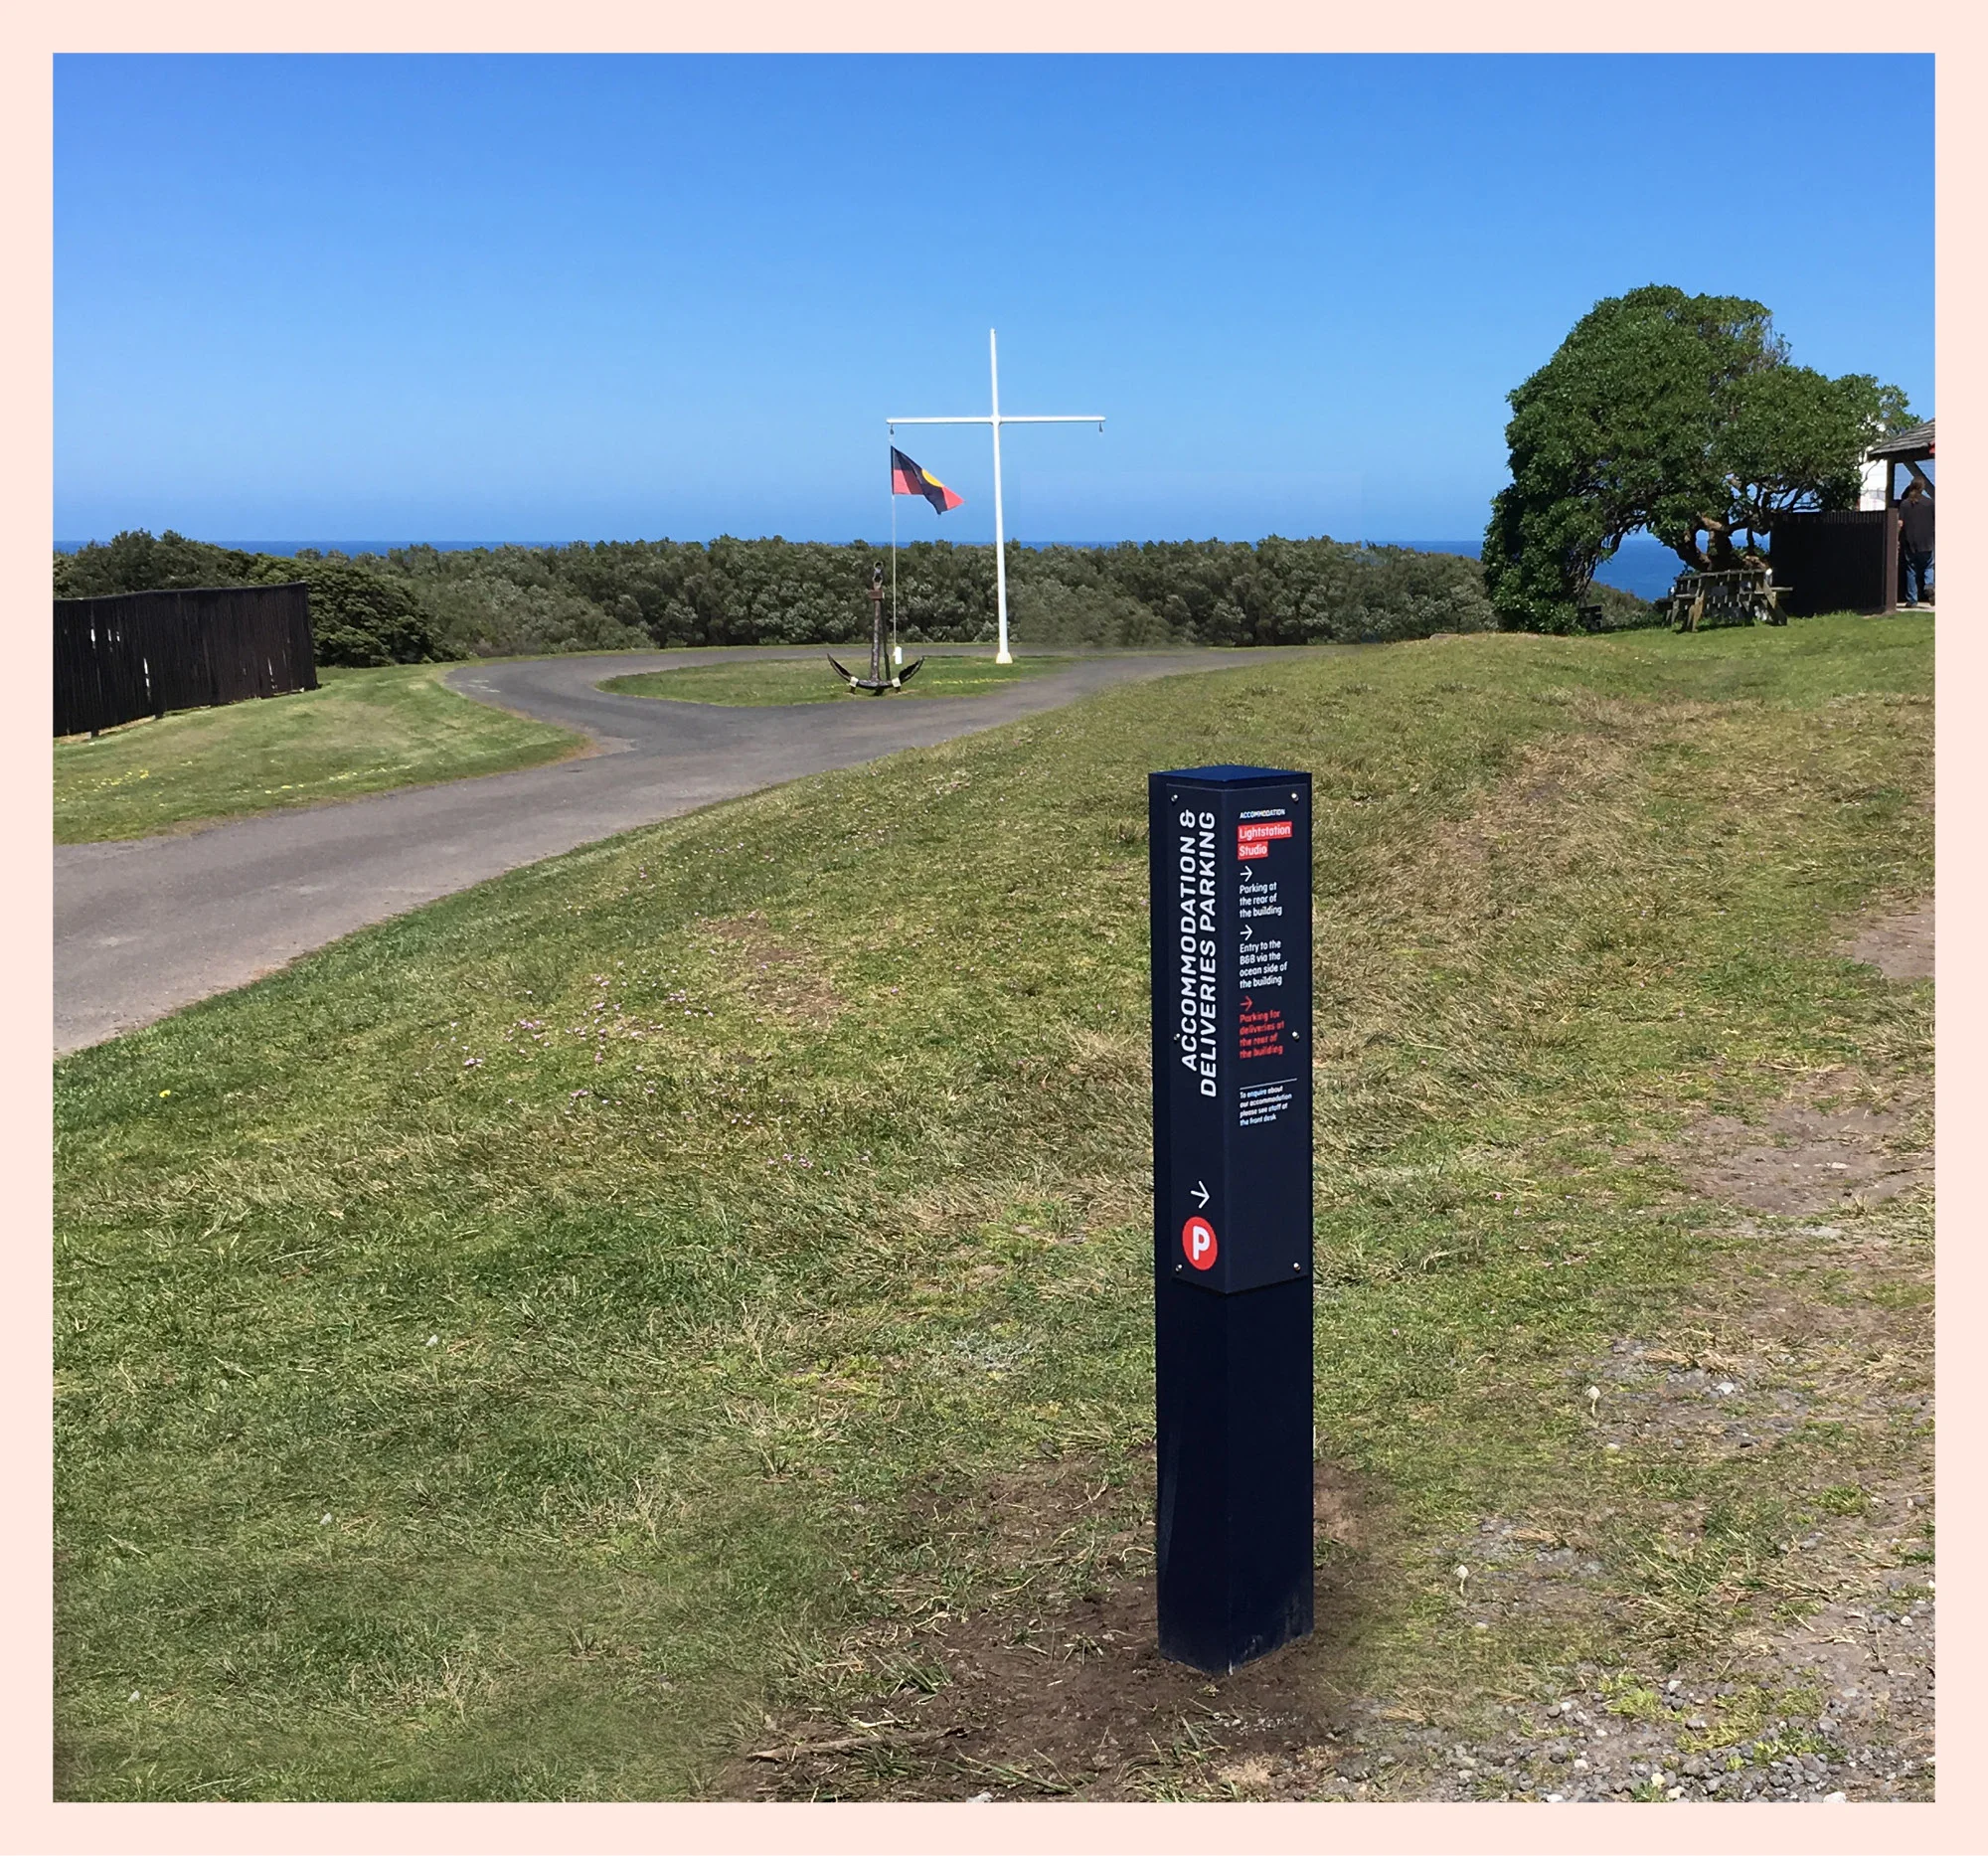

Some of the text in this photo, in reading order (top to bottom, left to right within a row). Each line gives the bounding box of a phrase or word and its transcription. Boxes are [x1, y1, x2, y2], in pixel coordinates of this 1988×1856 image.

[1239, 808, 1286, 819] ACCOMMODATION
[1239, 823, 1291, 841] Lightstation
[1239, 843, 1268, 857] Studio
[1239, 881, 1277, 895] Parking at
[1239, 893, 1277, 907] the rear of
[1239, 905, 1283, 919] the building
[1179, 809, 1197, 1072] ACCOMMODATION &
[1240, 939, 1281, 953] Entry to the
[1199, 812, 1217, 1097] DELIVERIES PARKING
[1240, 951, 1281, 965] B&B via the
[1239, 960, 1288, 977] ocean side of
[1239, 975, 1283, 989] the building
[1240, 1009, 1281, 1023] Parking for
[1240, 1020, 1285, 1036] deliveries at
[1240, 1032, 1278, 1047] the rear of
[1240, 1044, 1283, 1059] the building
[1193, 1225, 1211, 1261] P
